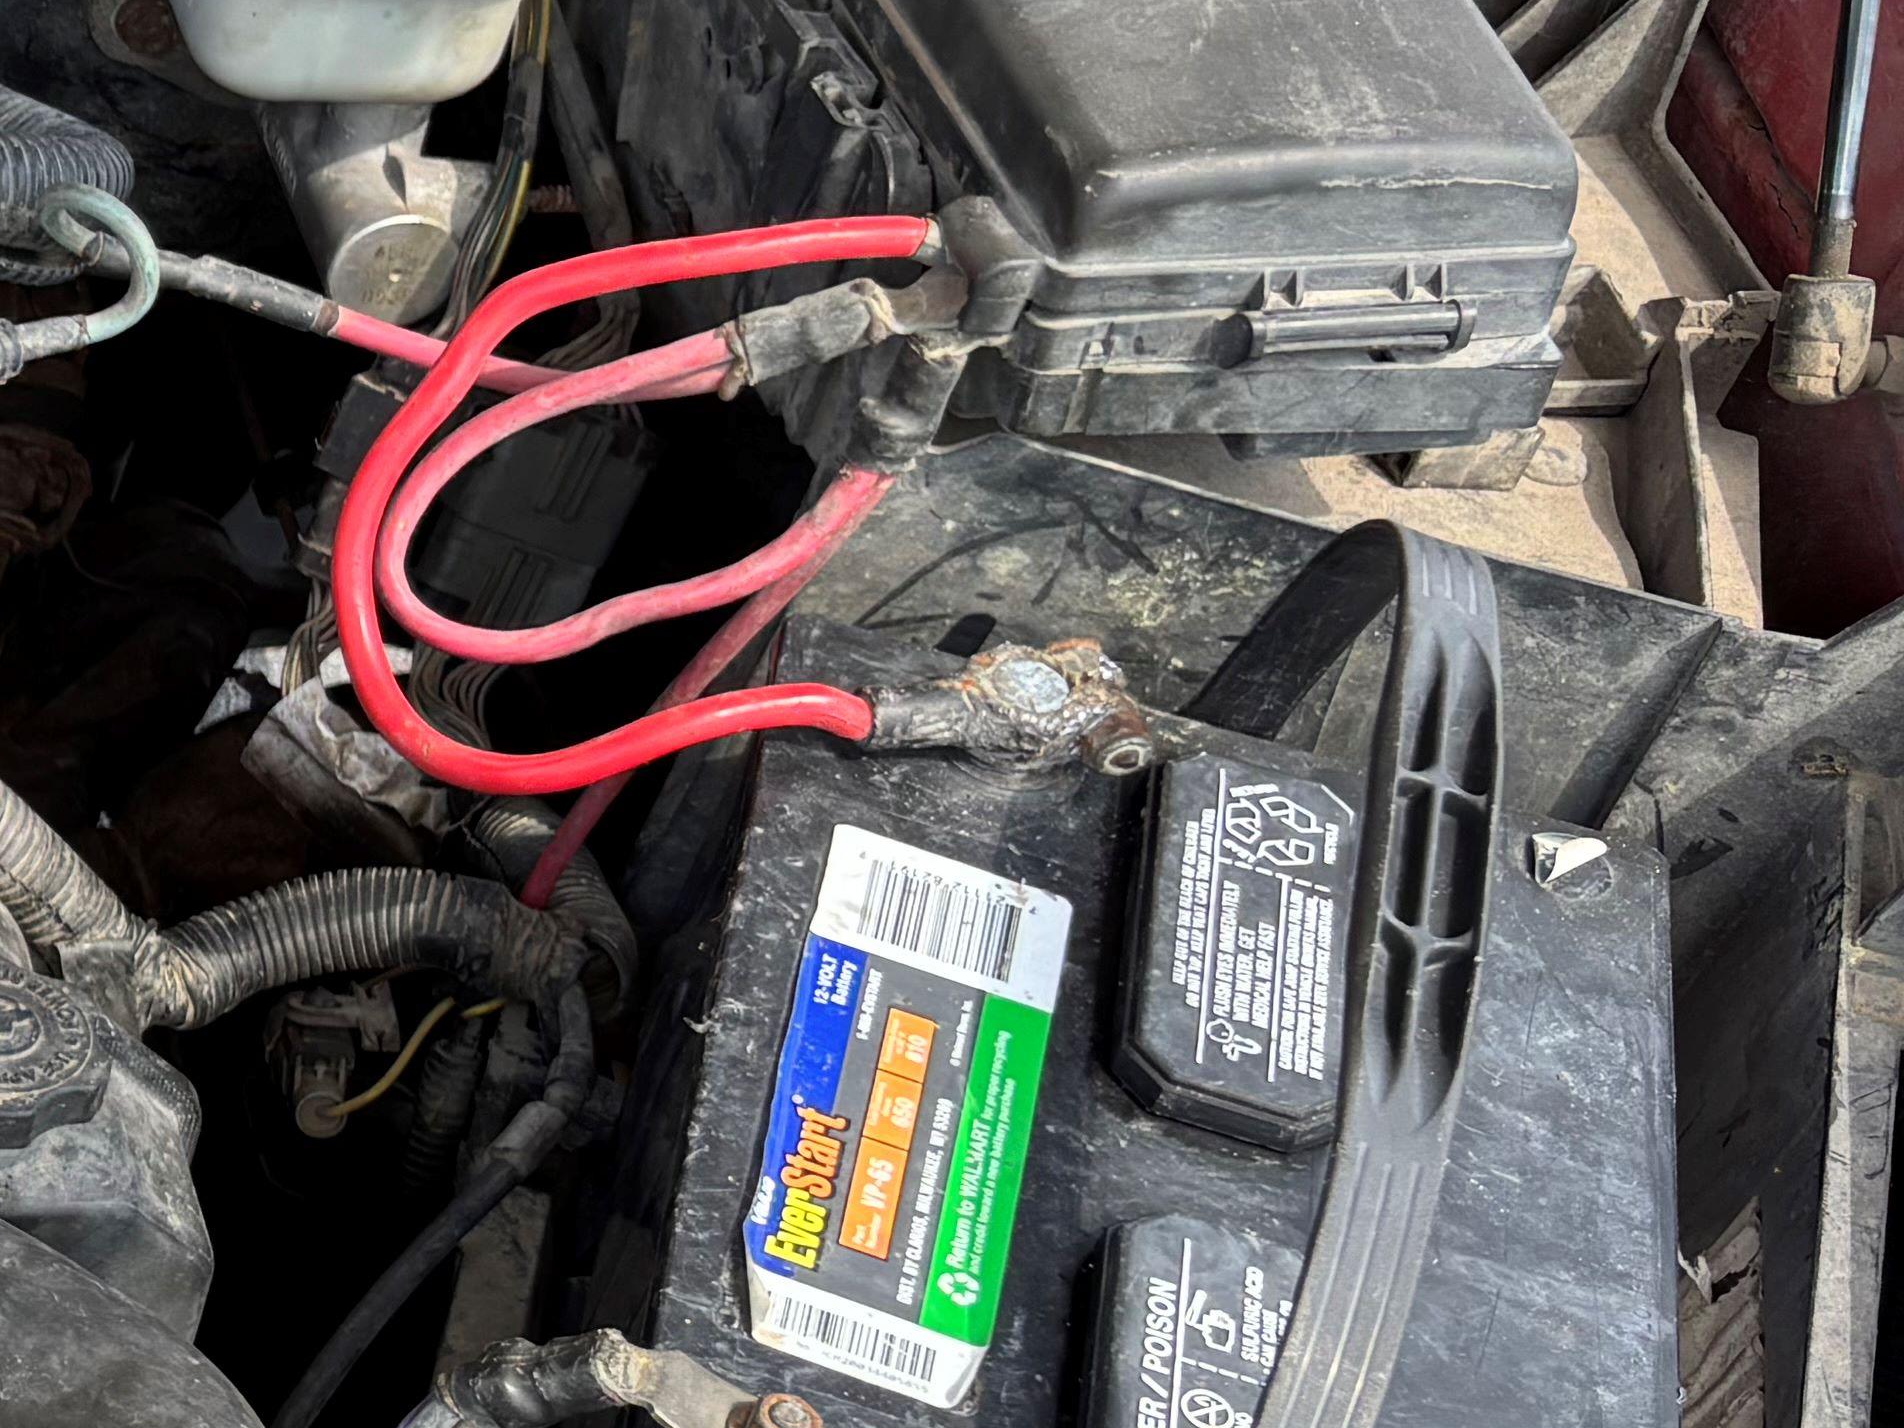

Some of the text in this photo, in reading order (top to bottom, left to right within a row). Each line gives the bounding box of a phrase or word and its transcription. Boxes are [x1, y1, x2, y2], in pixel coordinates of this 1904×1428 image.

[1237, 926, 1256, 950] GET
[813, 953, 838, 1005] 12-VOLT
[830, 960, 858, 1006] Battery
[1215, 952, 1235, 983] EYES
[1251, 921, 1276, 1029] MEDICAL HELP FAST
[1212, 980, 1233, 1018] FLUSH
[1232, 992, 1251, 1022] WITH
[991, 1030, 1012, 1075] recycling
[998, 1078, 1015, 1123] purchase
[989, 1121, 1009, 1159] battery
[762, 1105, 847, 1269] EverStart
[987, 1158, 1000, 1180] new
[956, 1199, 976, 1216] to
[976, 1187, 994, 1224] toward
[945, 1217, 972, 1270] Return
[973, 1223, 987, 1255] credit
[1240, 1266, 1265, 1363] SULFURIC ACID
